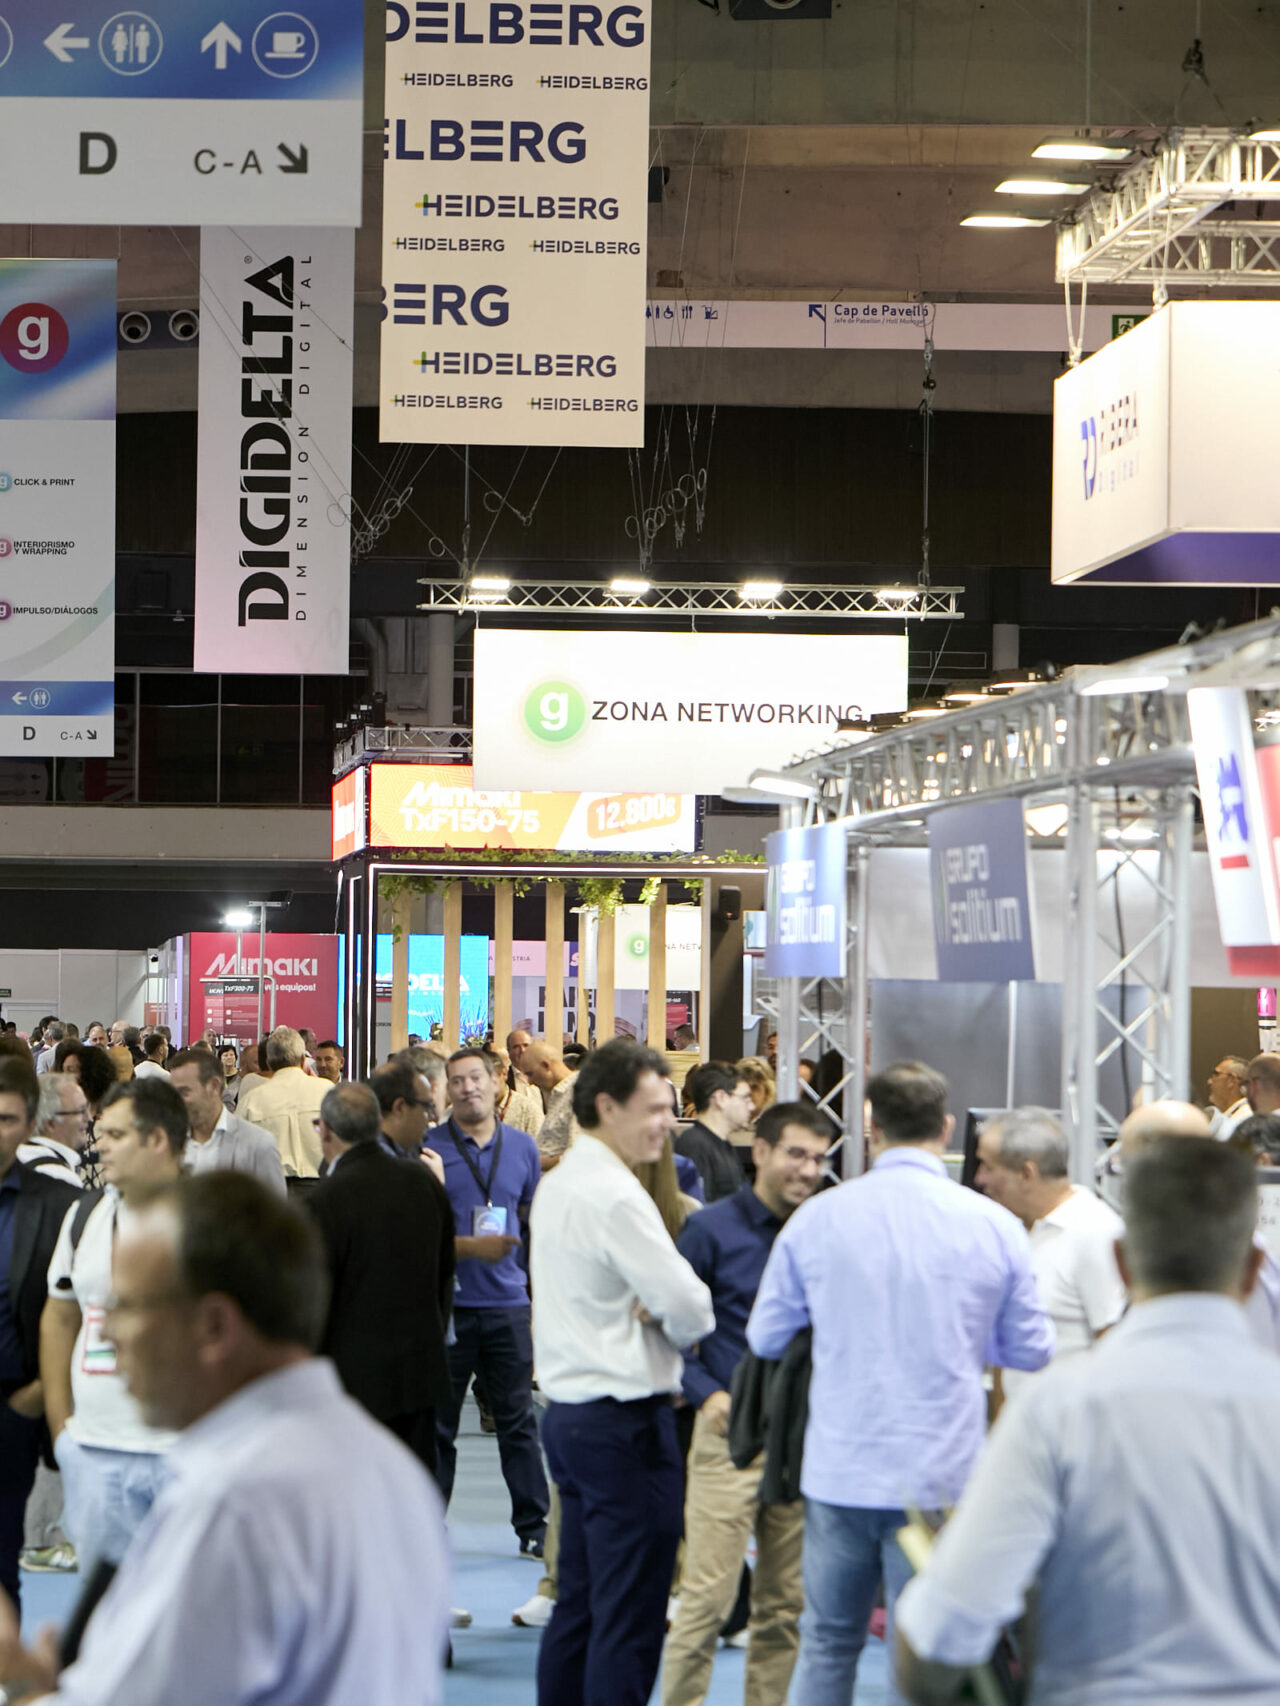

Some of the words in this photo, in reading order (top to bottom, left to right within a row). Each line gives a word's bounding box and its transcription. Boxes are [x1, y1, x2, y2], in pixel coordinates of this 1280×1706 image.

[400, 73, 513, 88] HEIDELBERG
[536, 75, 648, 91] HEIDELBERG
[384, 118, 587, 164] LBERG
[79, 132, 117, 175] D
[193, 149, 262, 175] C-A
[414, 194, 620, 220] HEIDELBERG
[392, 237, 505, 252] HEIDELBERG
[528, 240, 641, 255] HEIDELBERG
[381, 283, 509, 327] ERG
[834, 304, 858, 319] Cap
[863, 305, 878, 316] de
[298, 255, 311, 395] DIGITAL
[17, 316, 49, 360] g
[413, 351, 617, 377] HEIDELBERG
[390, 394, 503, 410] HEIDELBERG
[527, 397, 639, 412] HEIDELBERG
[238, 255, 294, 627] DIGIDELTA
[13, 478, 40, 486] CLICK
[49, 478, 75, 486] PRINT
[295, 426, 310, 621] DIMENSION
[13, 541, 75, 549] INTERIORISMO
[591, 701, 668, 722] ZONA
[676, 702, 864, 725] NETWORKING
[23, 726, 36, 741] D
